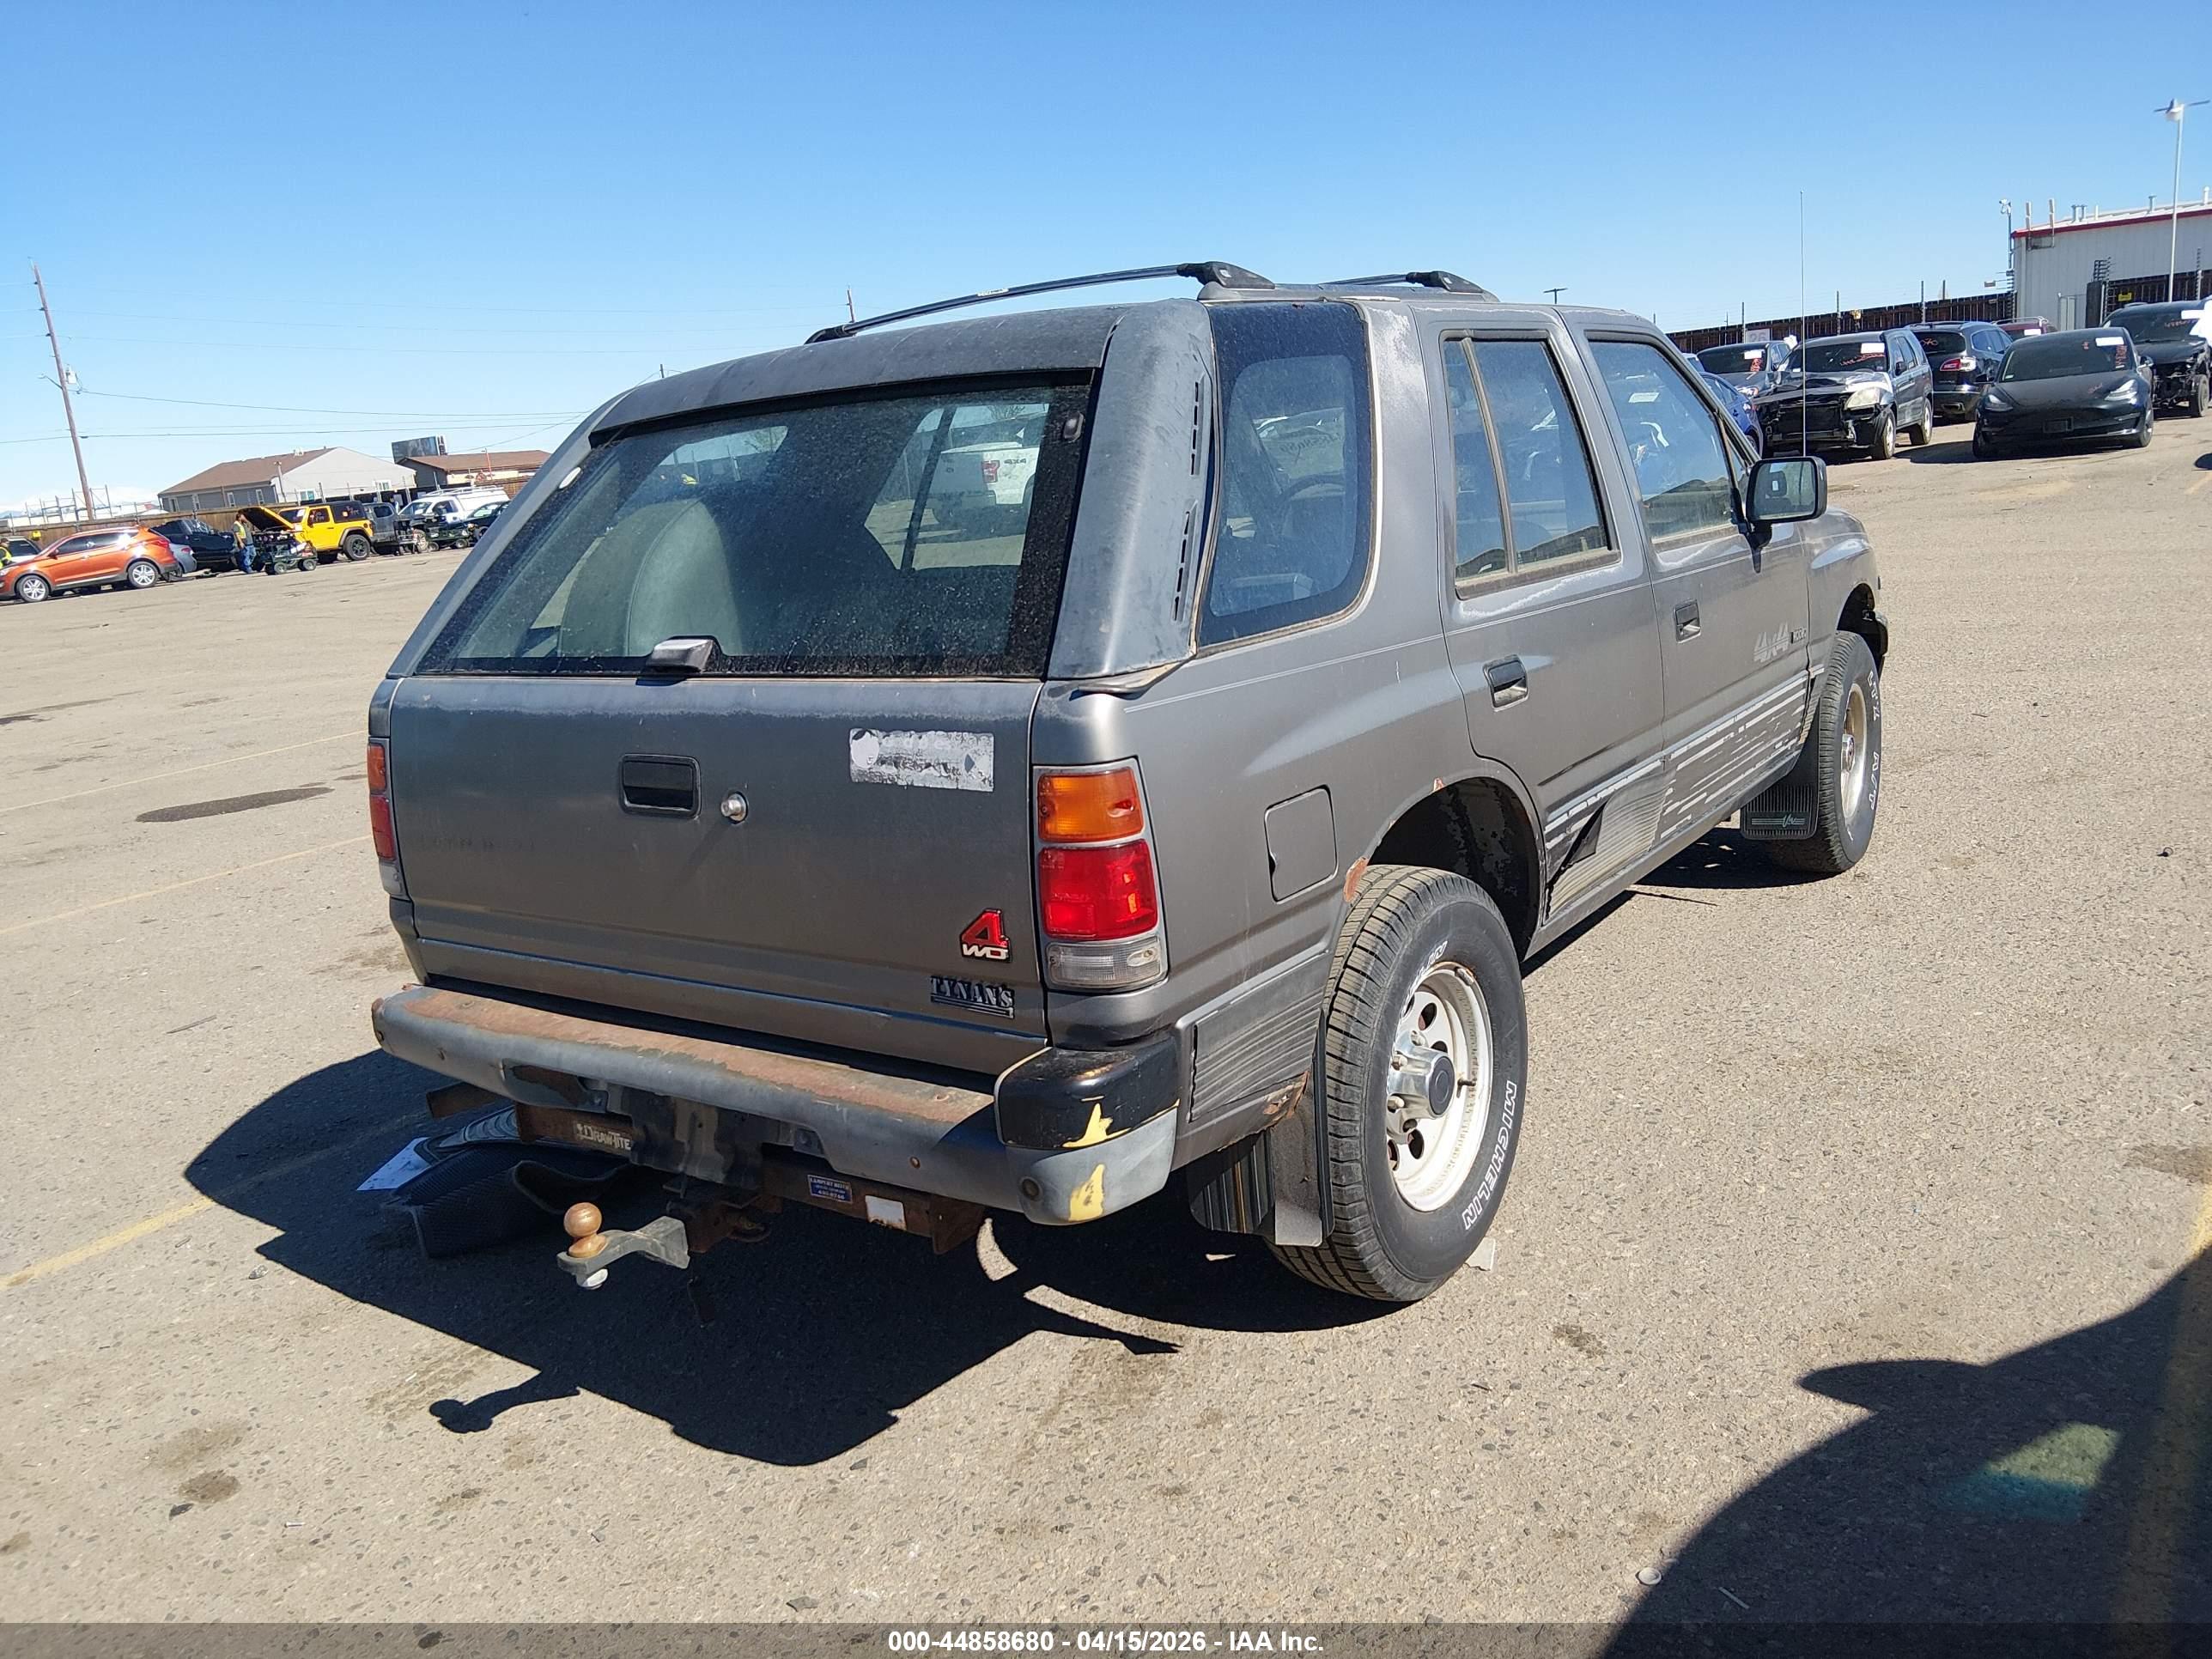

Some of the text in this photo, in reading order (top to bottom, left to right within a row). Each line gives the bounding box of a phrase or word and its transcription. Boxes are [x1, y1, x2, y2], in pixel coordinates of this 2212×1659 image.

[960, 908, 1009, 948] 4
[961, 943, 1010, 961] WD
[930, 975, 1014, 1008] TYNAN'S
[1462, 1079, 1517, 1231] MICHELIN
